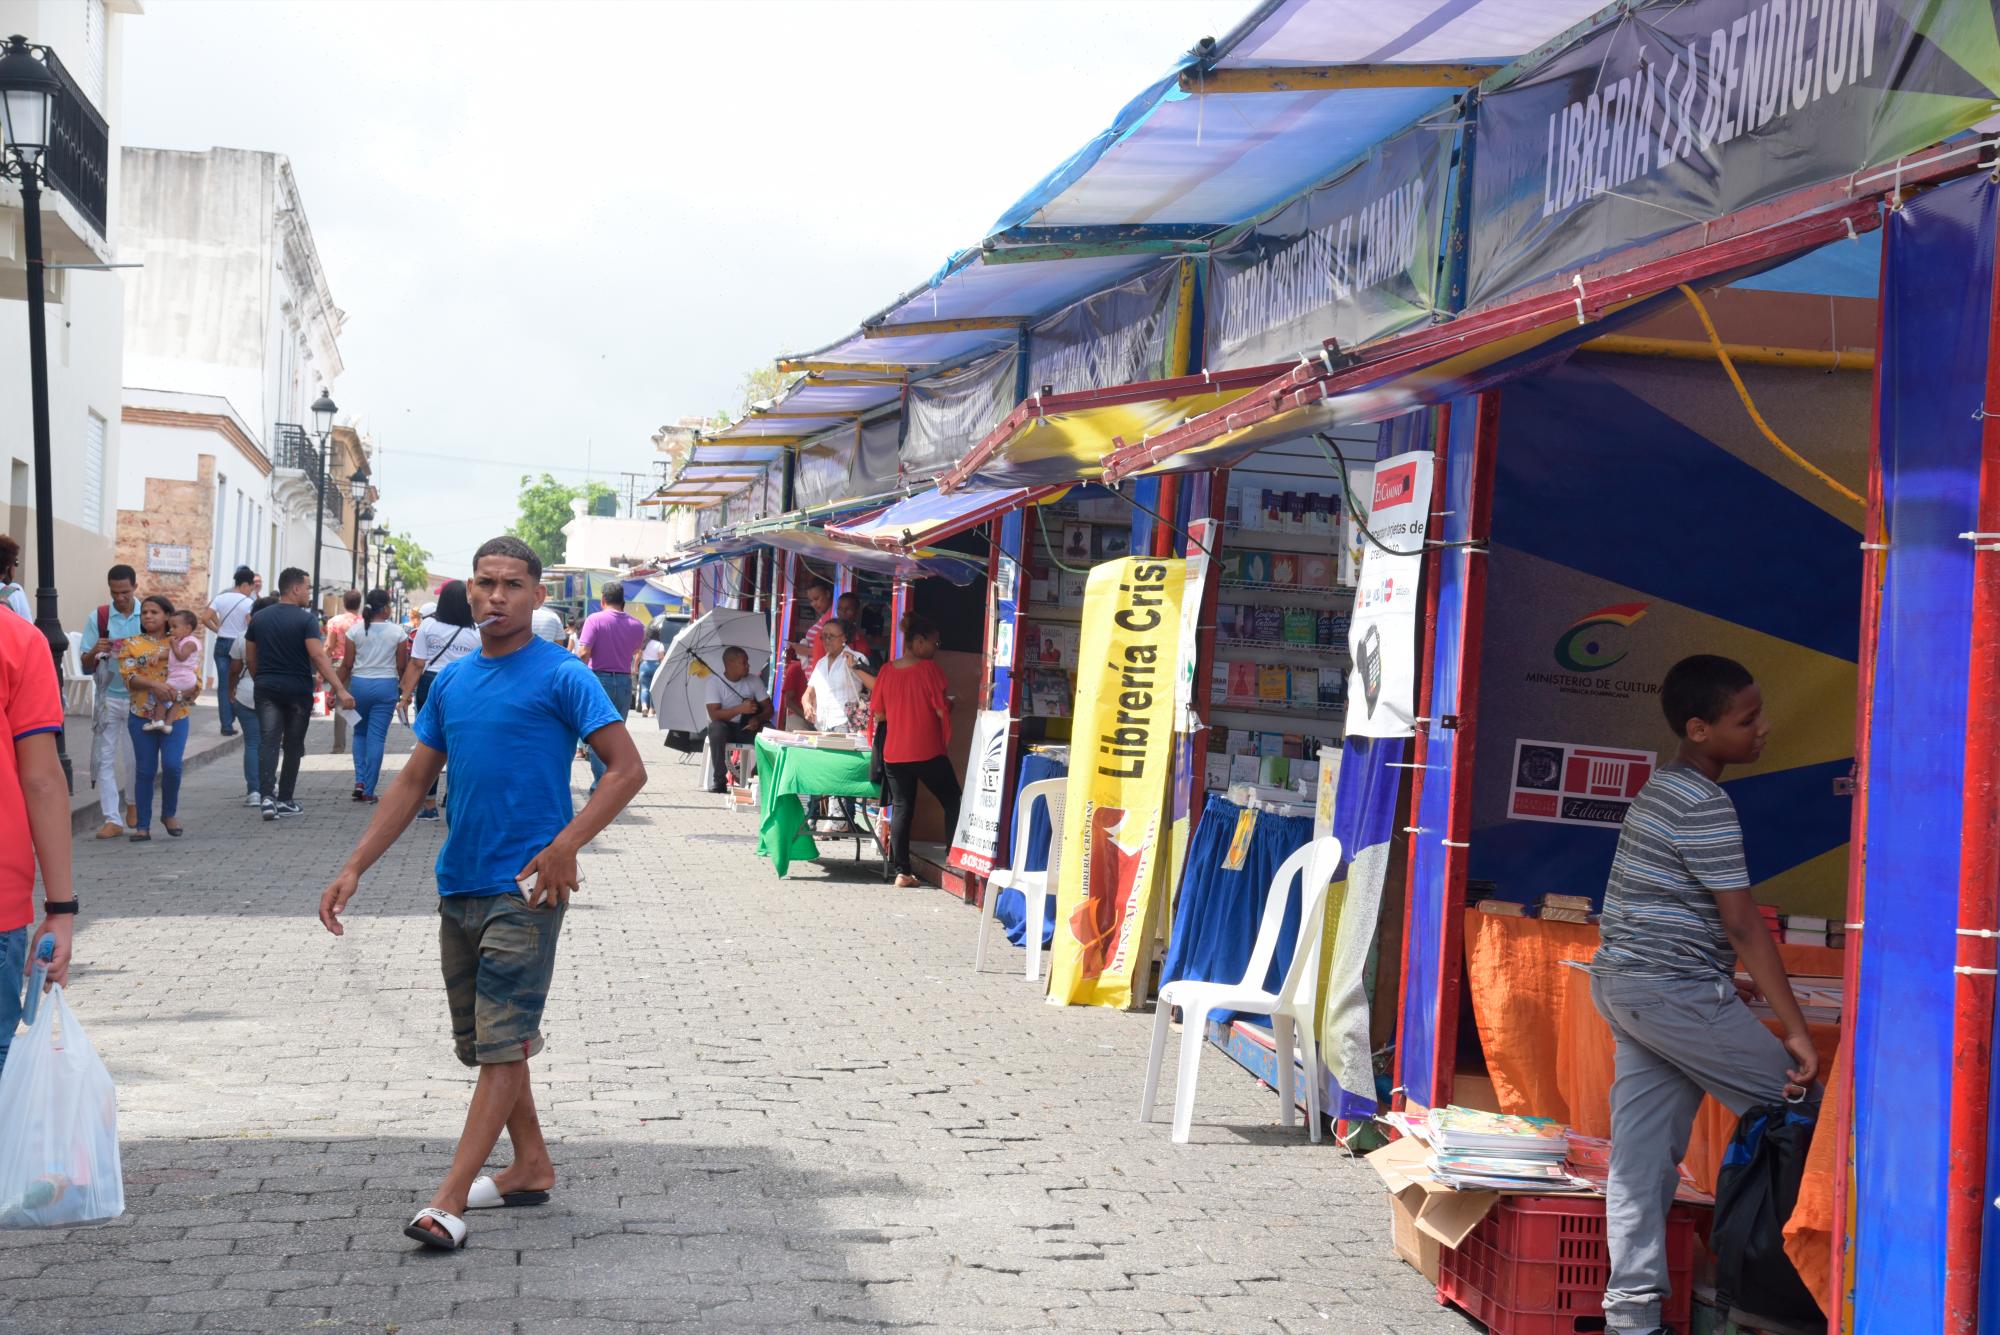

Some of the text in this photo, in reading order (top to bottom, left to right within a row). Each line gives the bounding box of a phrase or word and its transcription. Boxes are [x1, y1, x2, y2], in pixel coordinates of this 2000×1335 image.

[1542, 45, 1656, 219] LIBRERÍA
[1657, 41, 1698, 170] LA
[1335, 215, 1354, 298] EL
[1356, 178, 1424, 292] CAMINO
[1409, 520, 1424, 534] de
[1098, 557, 1168, 779] Librería Cris
[1525, 672, 1592, 687] MINISTERIO
[1595, 679, 1611, 690] DE
[1083, 800, 1094, 851] CRISTIANA
[1112, 883, 1141, 973] MENSAJES
